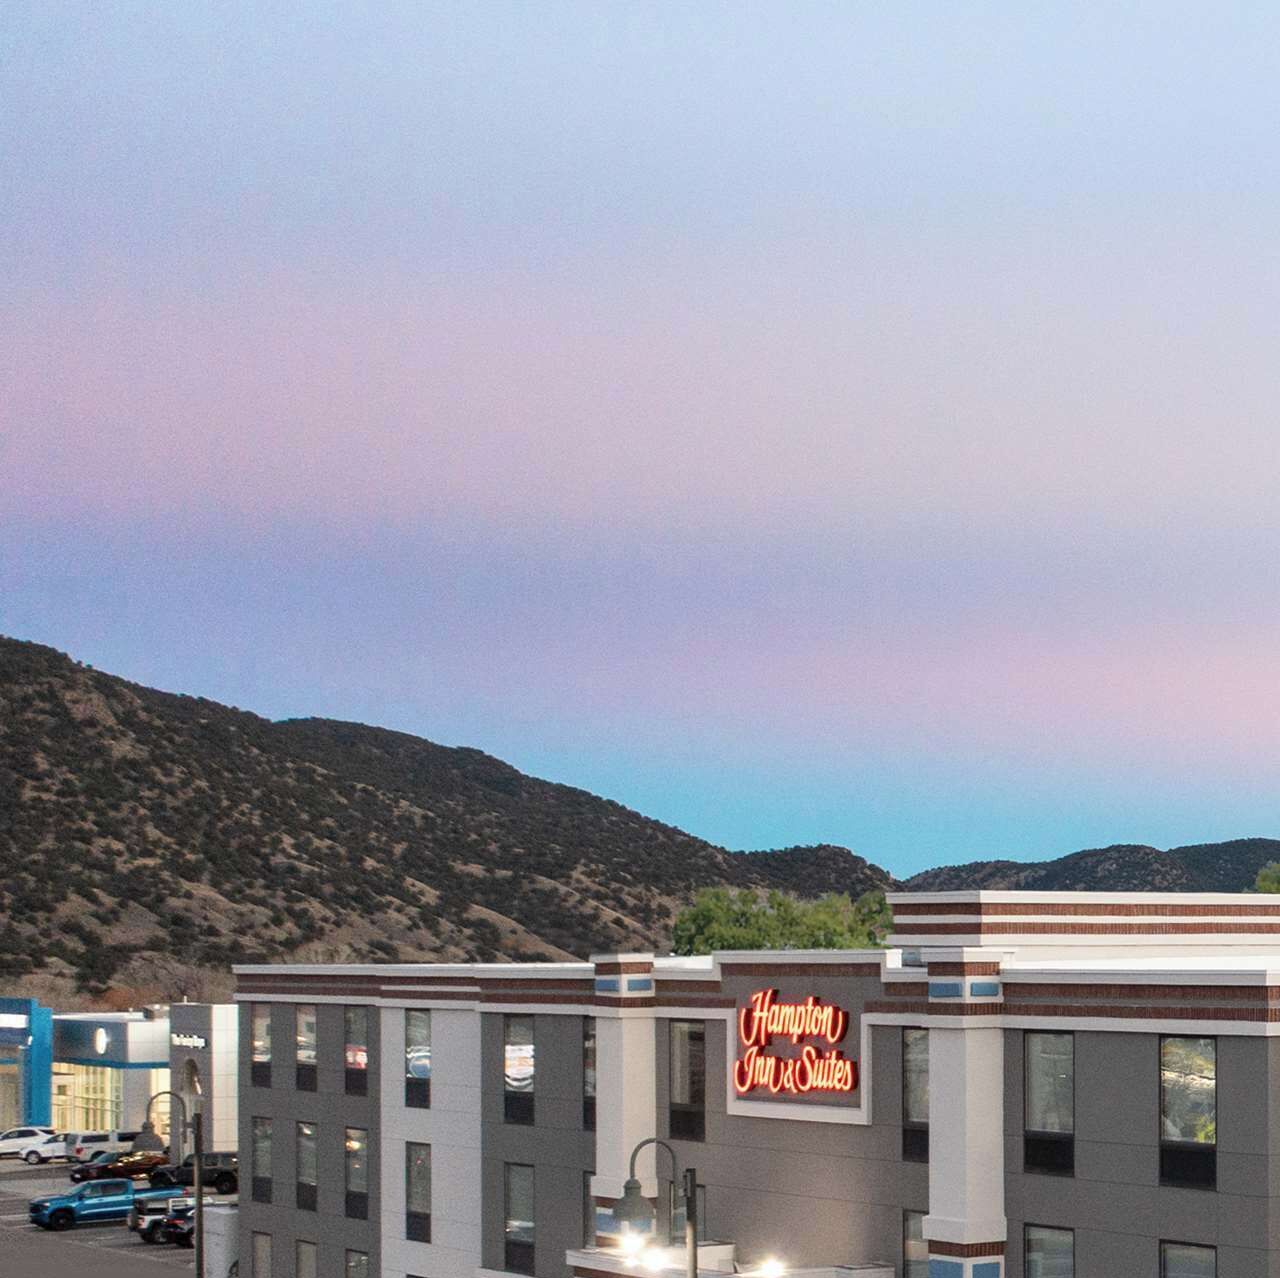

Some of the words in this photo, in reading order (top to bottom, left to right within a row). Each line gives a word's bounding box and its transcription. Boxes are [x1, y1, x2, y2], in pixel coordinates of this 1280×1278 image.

[740, 988, 846, 1046] Hampton
[734, 1046, 785, 1093] Inn
[783, 1059, 798, 1093] &
[795, 1045, 855, 1091] Suites
